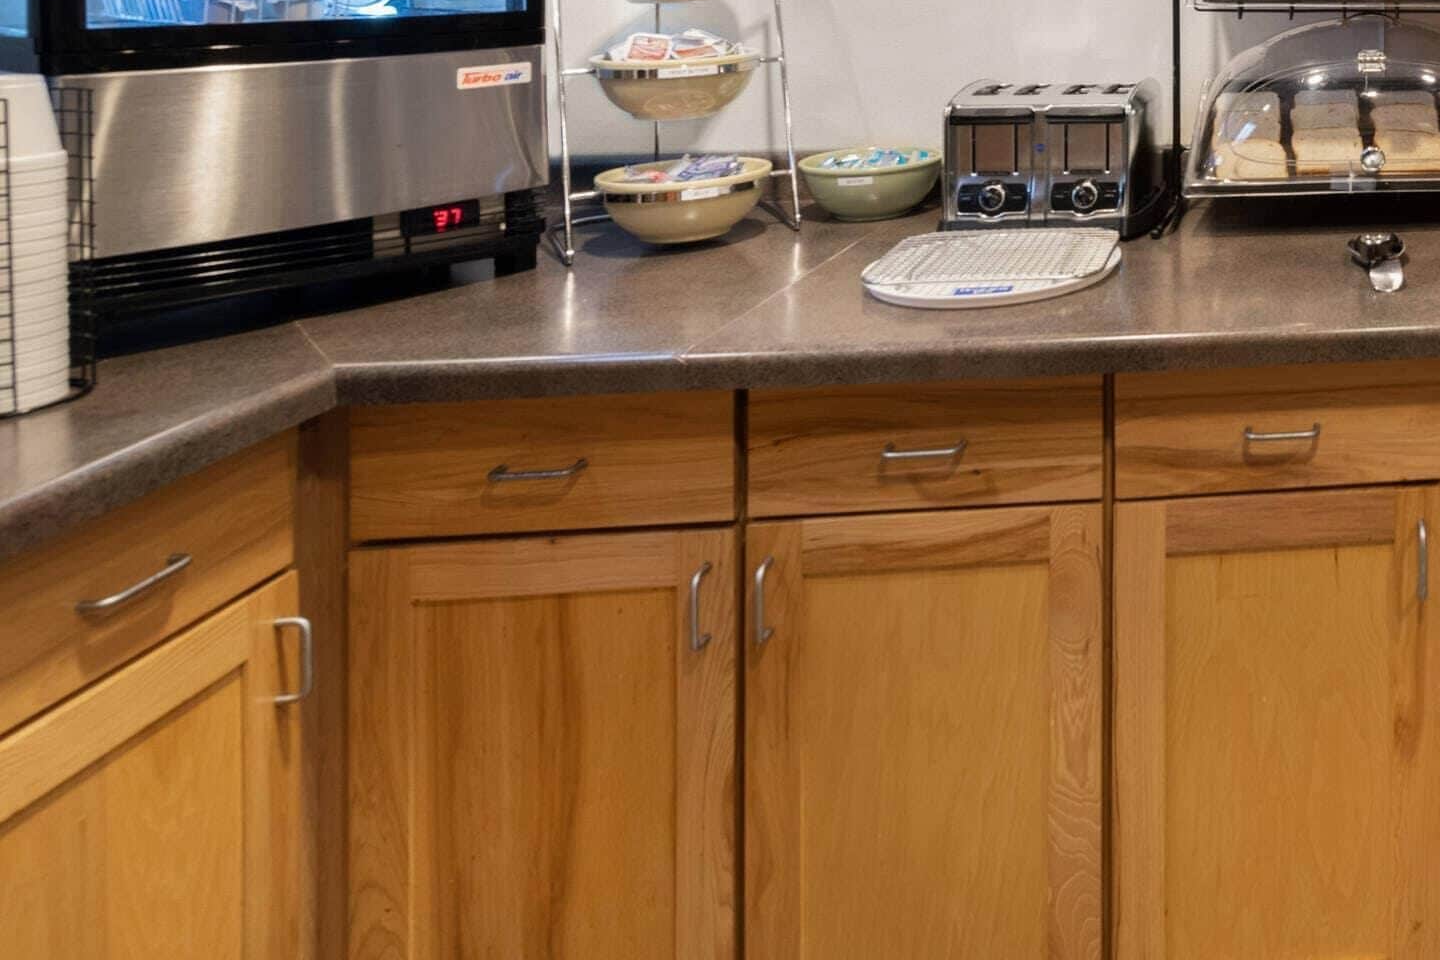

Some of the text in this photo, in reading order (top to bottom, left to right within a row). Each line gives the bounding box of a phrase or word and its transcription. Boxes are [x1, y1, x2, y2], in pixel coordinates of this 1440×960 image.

[461, 70, 523, 86] Turbo air
[433, 207, 464, 228] 37
